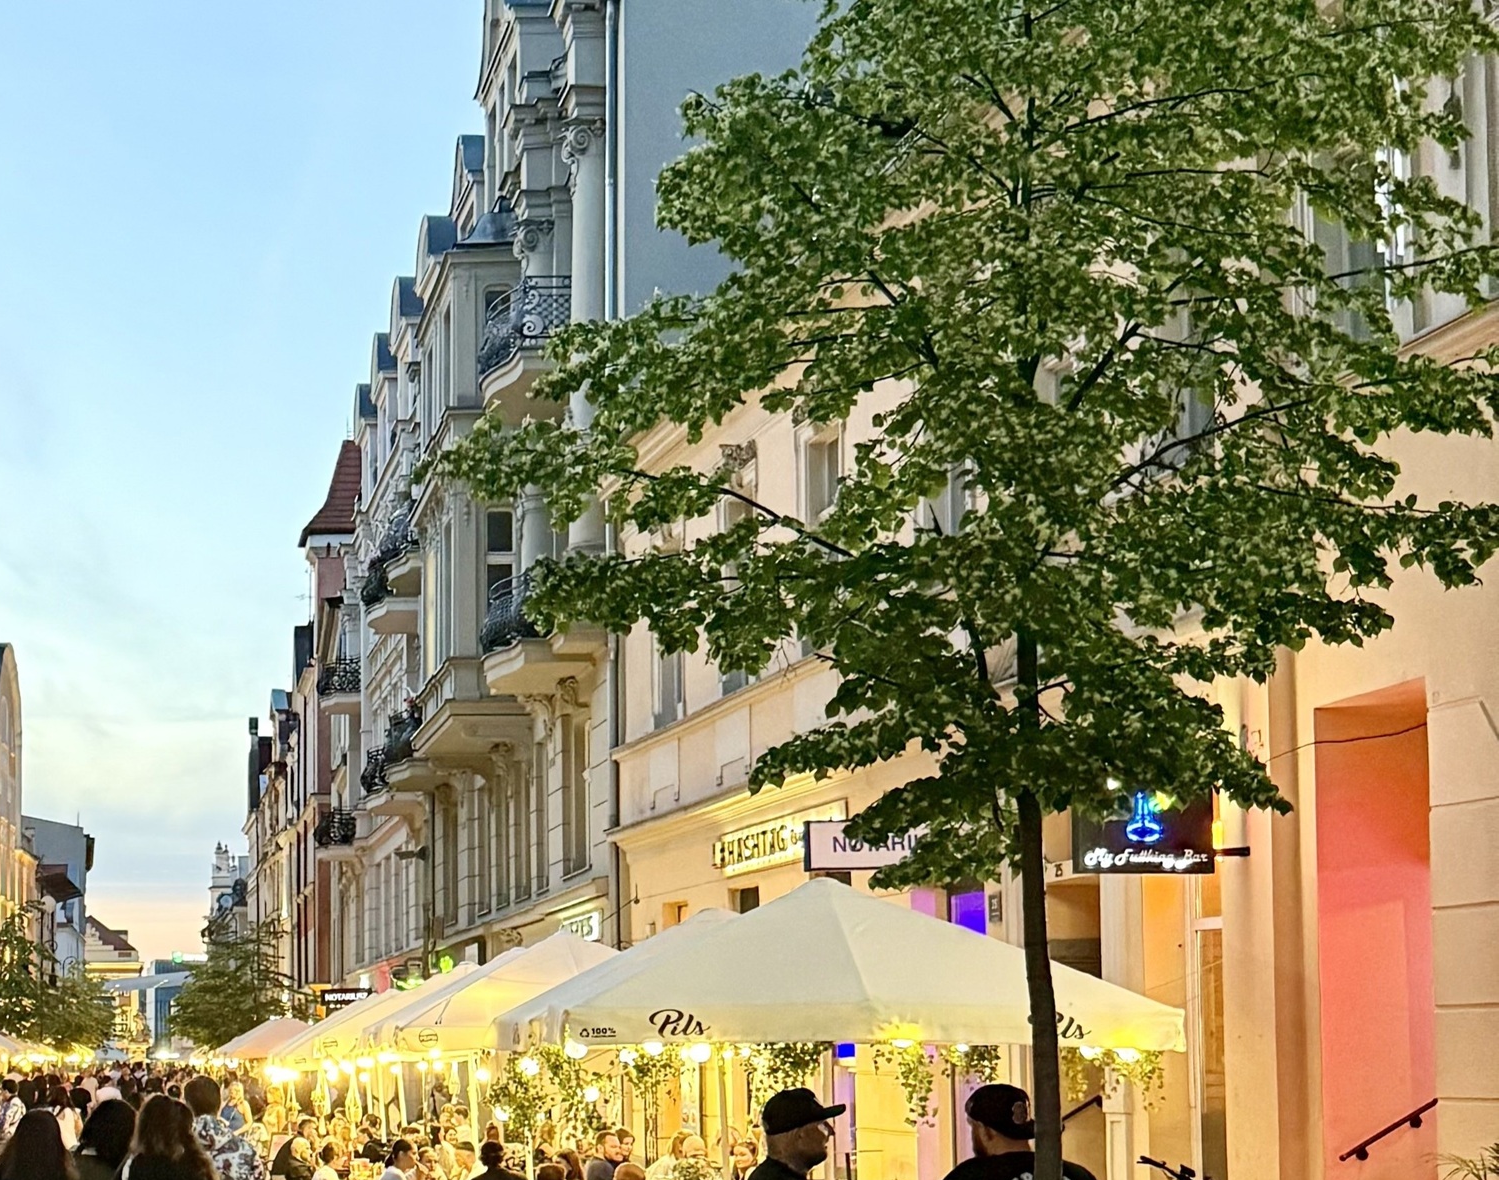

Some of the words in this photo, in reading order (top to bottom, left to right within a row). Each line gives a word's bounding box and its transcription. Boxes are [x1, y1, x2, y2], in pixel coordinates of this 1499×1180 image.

[1174, 848, 1209, 869] Bar
[591, 1027, 617, 1035] 100%
[648, 1008, 711, 1038] Pils
